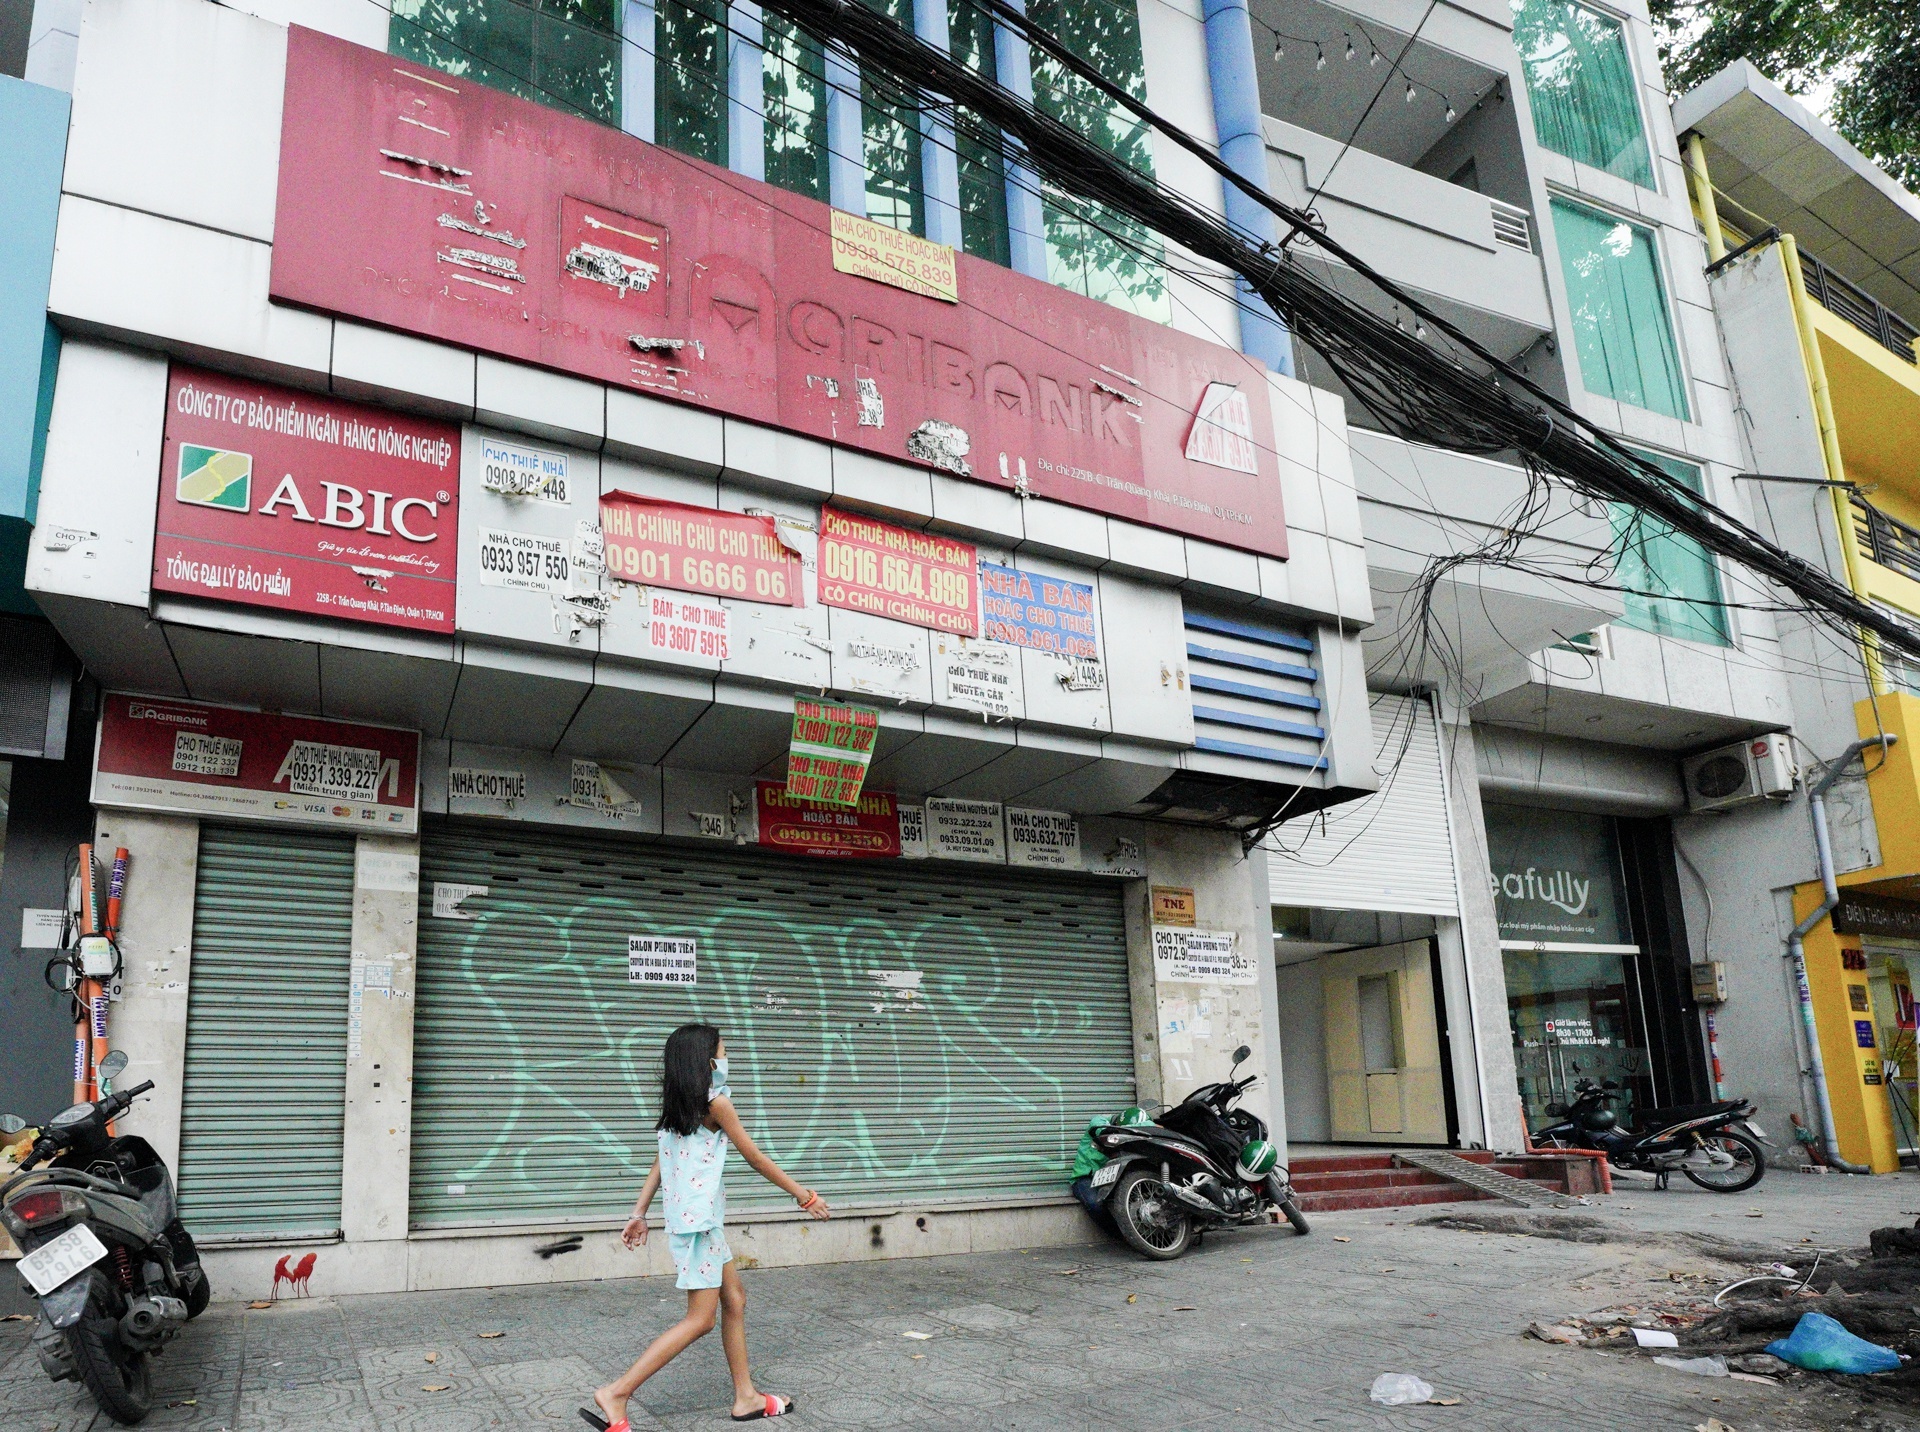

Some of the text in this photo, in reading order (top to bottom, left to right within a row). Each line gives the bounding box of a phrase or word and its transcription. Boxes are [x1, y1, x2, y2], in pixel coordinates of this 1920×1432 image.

[834, 216, 854, 236] NHÀ
[856, 223, 877, 243] CHO
[878, 232, 903, 252] THUÊ
[835, 238, 952, 286] 0938.575.839
[852, 263, 881, 280] CHÍNH
[177, 383, 452, 472] CÔNG TY CP BẢO HIỂM NGÂN HÀNG NÔNG NGHIỆP
[603, 504, 634, 538] NHÀ
[638, 510, 682, 546] CHÍNH
[686, 518, 716, 554] CHỦ
[720, 528, 748, 558] CHO
[826, 514, 850, 536] CHO
[851, 521, 883, 545] THUÊ
[885, 530, 910, 552] NHÀ
[912, 540, 944, 564] HOẶC
[946, 545, 969, 568] BÁN
[488, 534, 561, 553] NHÀ CHO THUÊ
[166, 551, 198, 582] TỔNG
[222, 563, 236, 588] LÝ
[237, 564, 262, 592] BẢO
[482, 545, 568, 581] 0933 957 550
[608, 544, 786, 600] 0901 6666 06
[825, 541, 969, 610] 0916.664.999
[982, 569, 1092, 614] NHÀ BÁN
[350, 598, 366, 612] Quang
[652, 598, 726, 630] BÁN CHO THUÊ
[824, 585, 846, 602] CÔ
[848, 590, 884, 612] CHÍN
[887, 600, 935, 624] (CHÍNH
[984, 596, 1094, 636] HOẶC CHO THUÊ
[652, 622, 728, 658] 09 3607 5915
[144, 710, 208, 726] AGRIBANK
[796, 700, 878, 730] CHO THUÊ NHÀ
[176, 736, 240, 757] CHO THUÊ NHÀ
[804, 720, 874, 751] 0901 122 332
[175, 761, 234, 776] 0912 131 139
[176, 752, 237, 766] 0901 122 332
[294, 744, 308, 762] CHO
[310, 745, 328, 764] THUÊ
[328, 746, 342, 766] NHÀ
[343, 748, 364, 769] CHÍNH
[790, 755, 865, 782] CHO THUÊ NHÀ
[293, 762, 378, 790] 0931.339.227
[452, 770, 525, 798] NHÀ CHO THUÊ
[794, 774, 860, 802] 0901 122 332
[322, 787, 348, 798] trung
[304, 804, 326, 814] VISA
[856, 794, 892, 817] NHÀ
[929, 801, 940, 811] CHO
[802, 810, 858, 826] HOẶC BÁN
[938, 816, 992, 828] 0932.322.324
[1010, 812, 1076, 832] NHÀ CHO THUÊ
[940, 835, 995, 846] 0933.09.01.09
[1013, 828, 1076, 847] 0939.632.707
[1163, 898, 1186, 910] TNE
[630, 940, 652, 952] SALON
[1156, 931, 1172, 944] CHO
[630, 971, 694, 982] LH: 0909 493 324
[1524, 1040, 1538, 1048] Push
